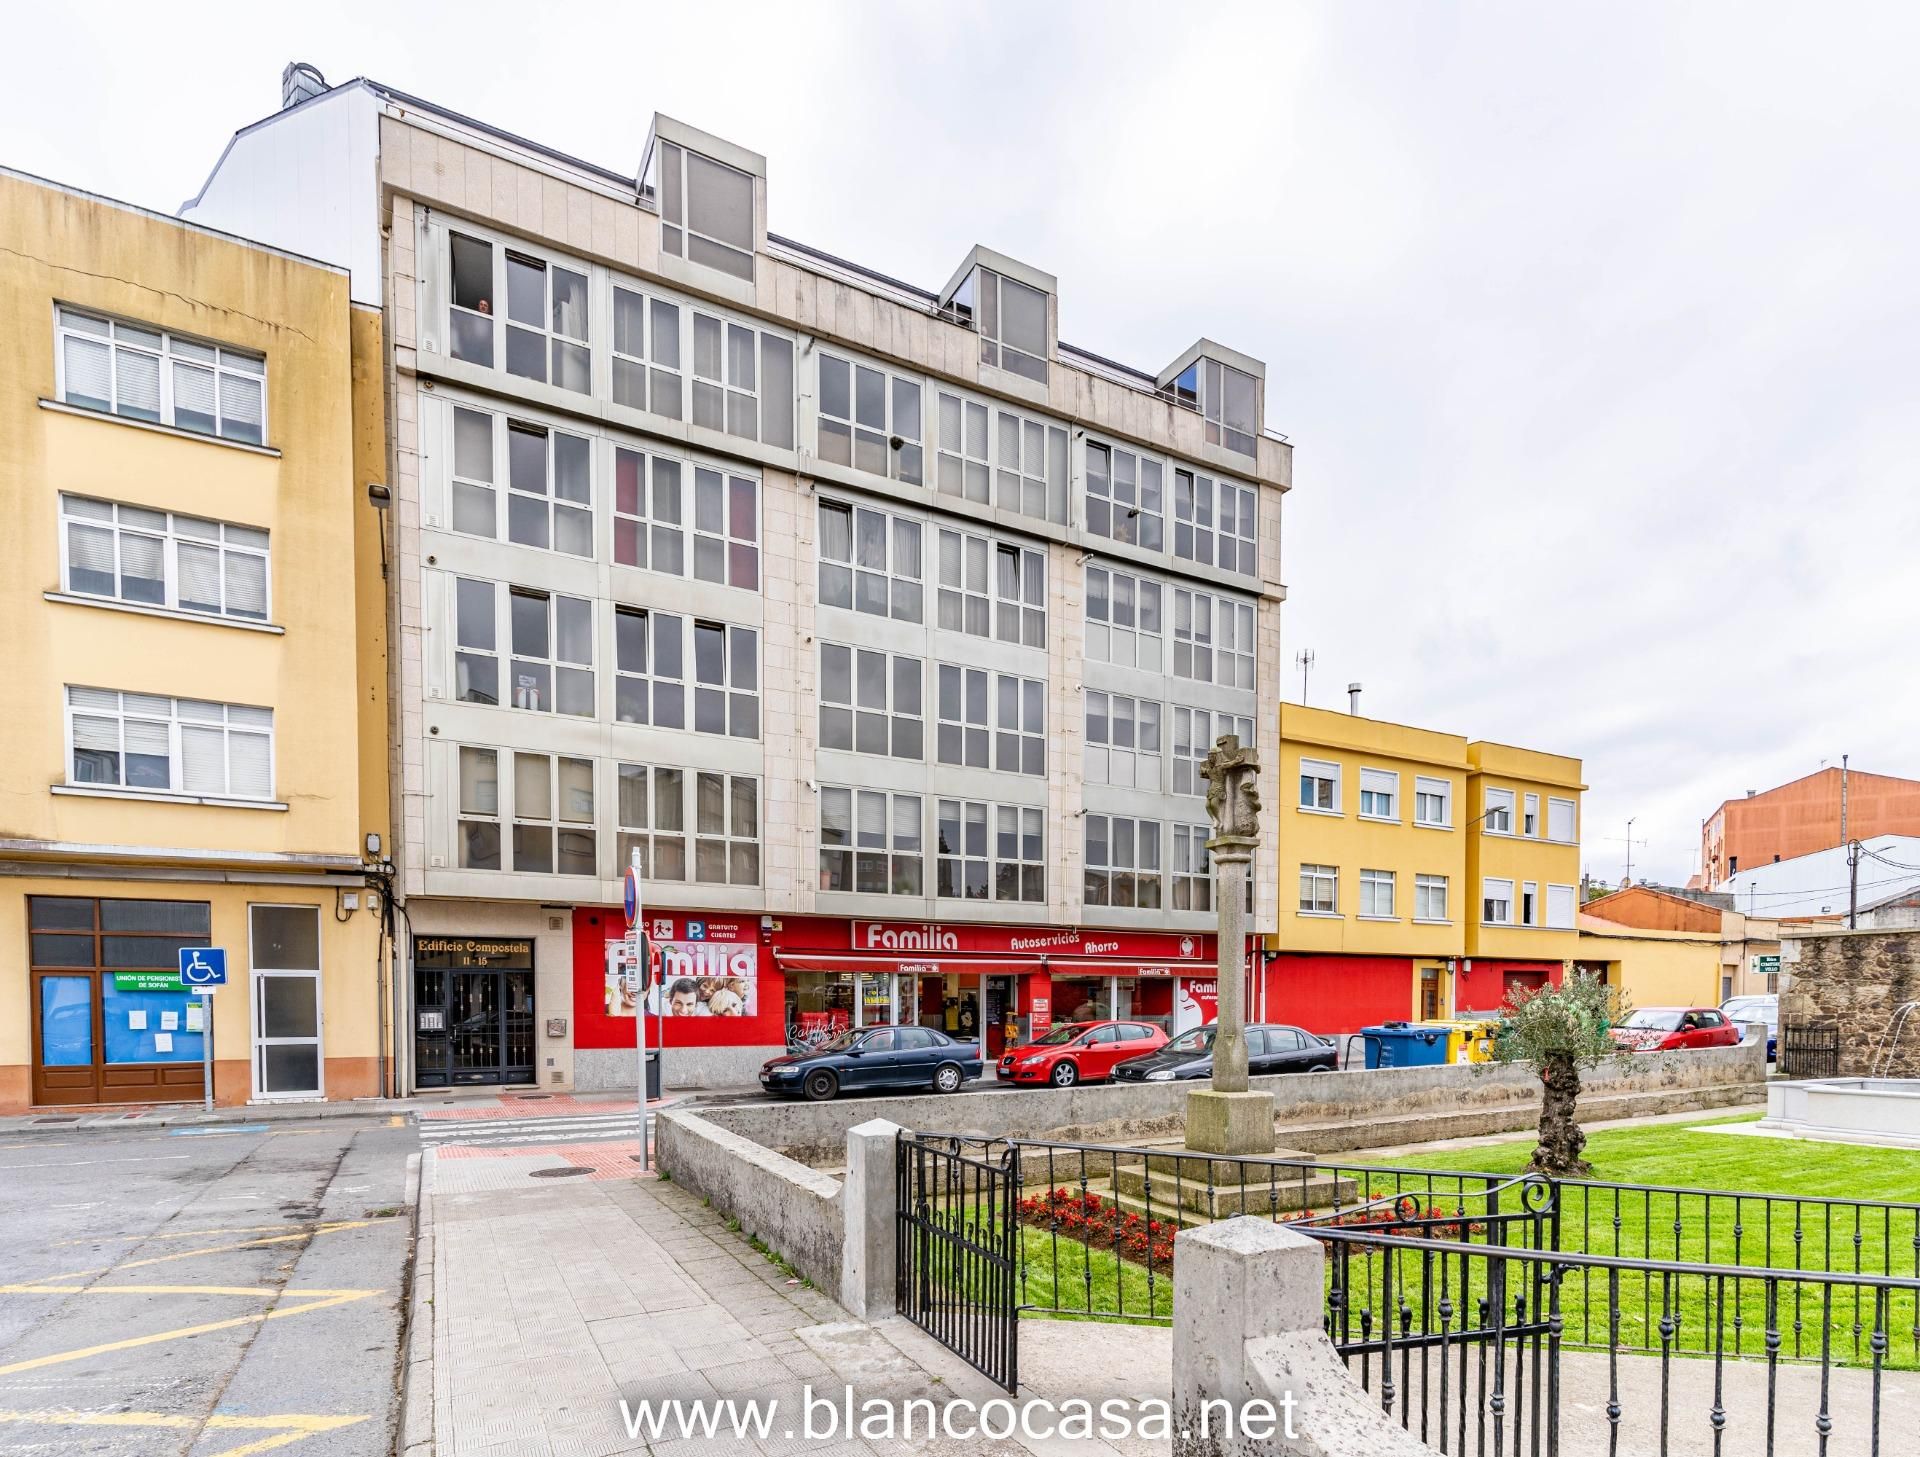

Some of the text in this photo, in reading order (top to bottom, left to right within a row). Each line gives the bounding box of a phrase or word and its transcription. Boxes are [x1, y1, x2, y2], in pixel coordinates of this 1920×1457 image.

[867, 924, 1119, 954] Familia Autoservicios Ahorro
[418, 940, 529, 954] Edificio Compostela
[478, 957, 488, 966] 15
[608, 941, 756, 977] Fmilia
[900, 964, 927, 972] Familia
[1189, 980, 1219, 993] Fami
